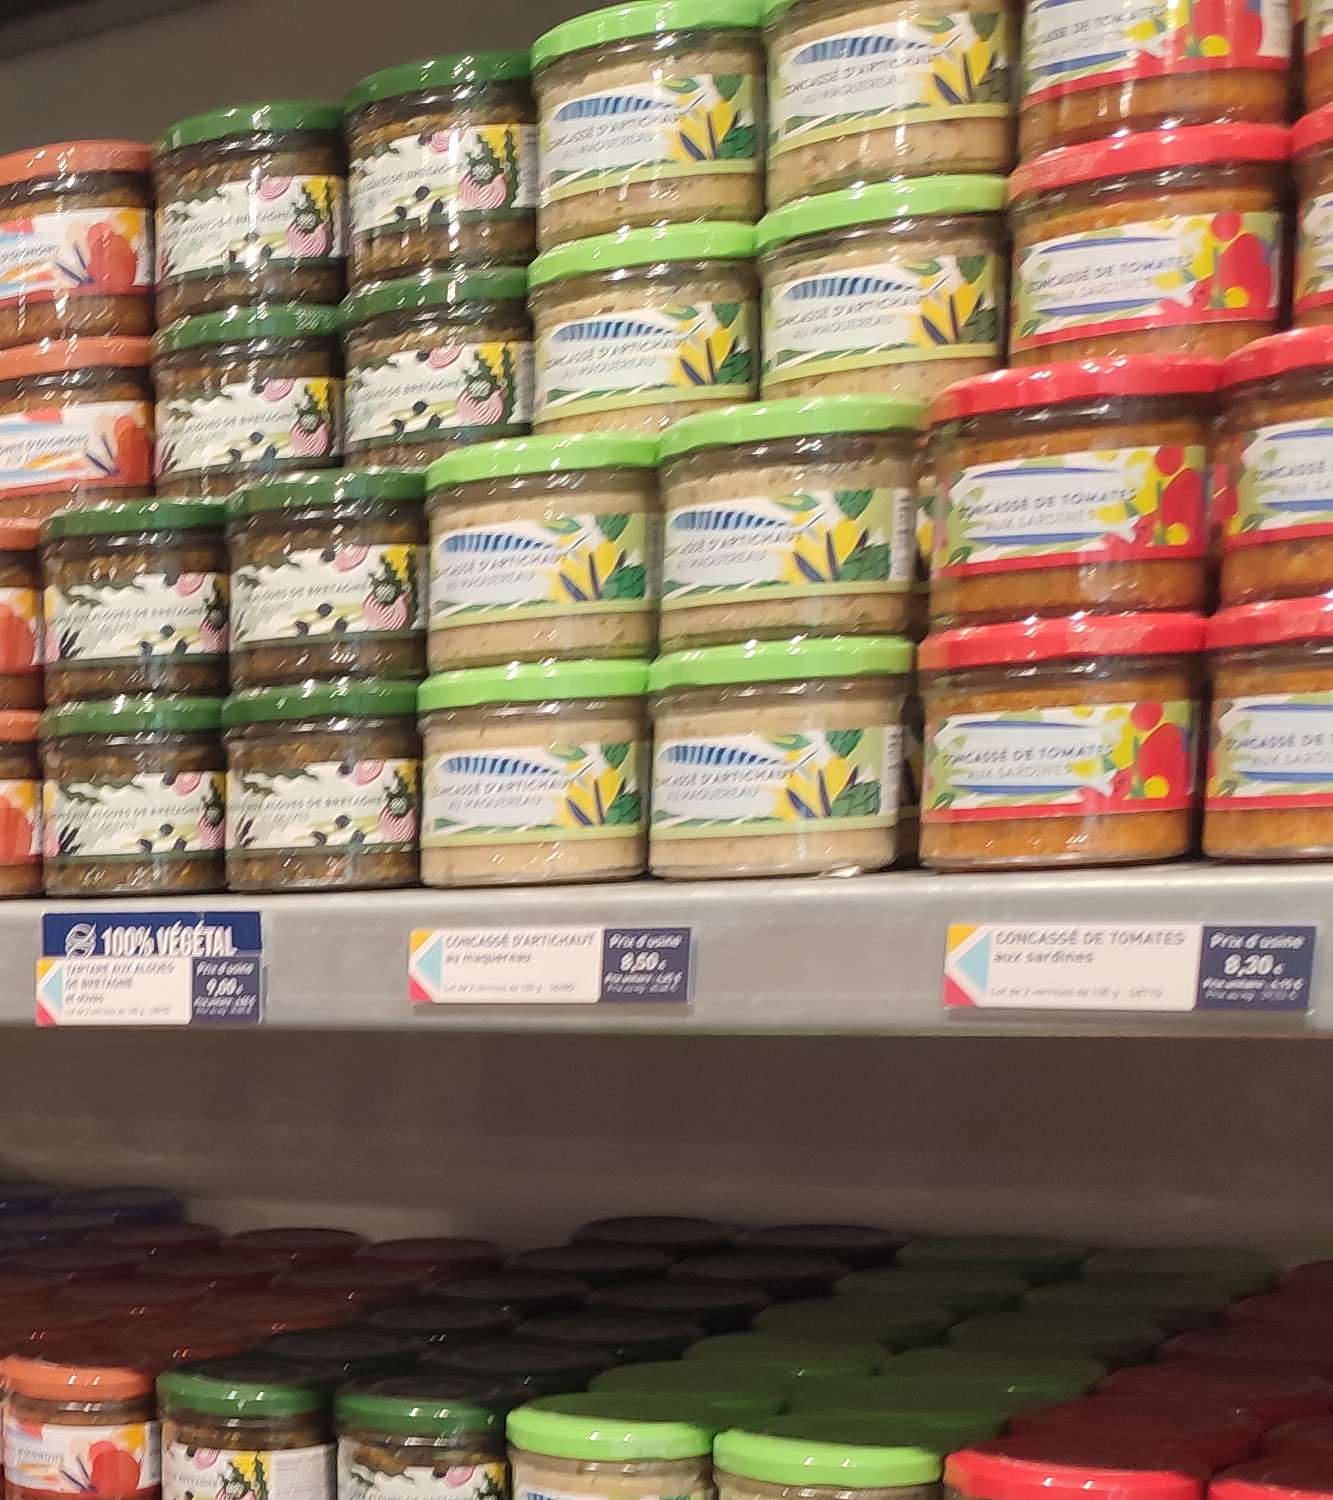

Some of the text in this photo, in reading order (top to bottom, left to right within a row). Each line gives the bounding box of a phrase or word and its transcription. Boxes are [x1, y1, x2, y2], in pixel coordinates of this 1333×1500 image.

[101, 919, 240, 957] 100% VÉGÉTAL
[995, 927, 1186, 946] CONCASSÉ DE TOMATES
[1209, 932, 1244, 950] Prix
[994, 949, 1094, 964] aux sardines
